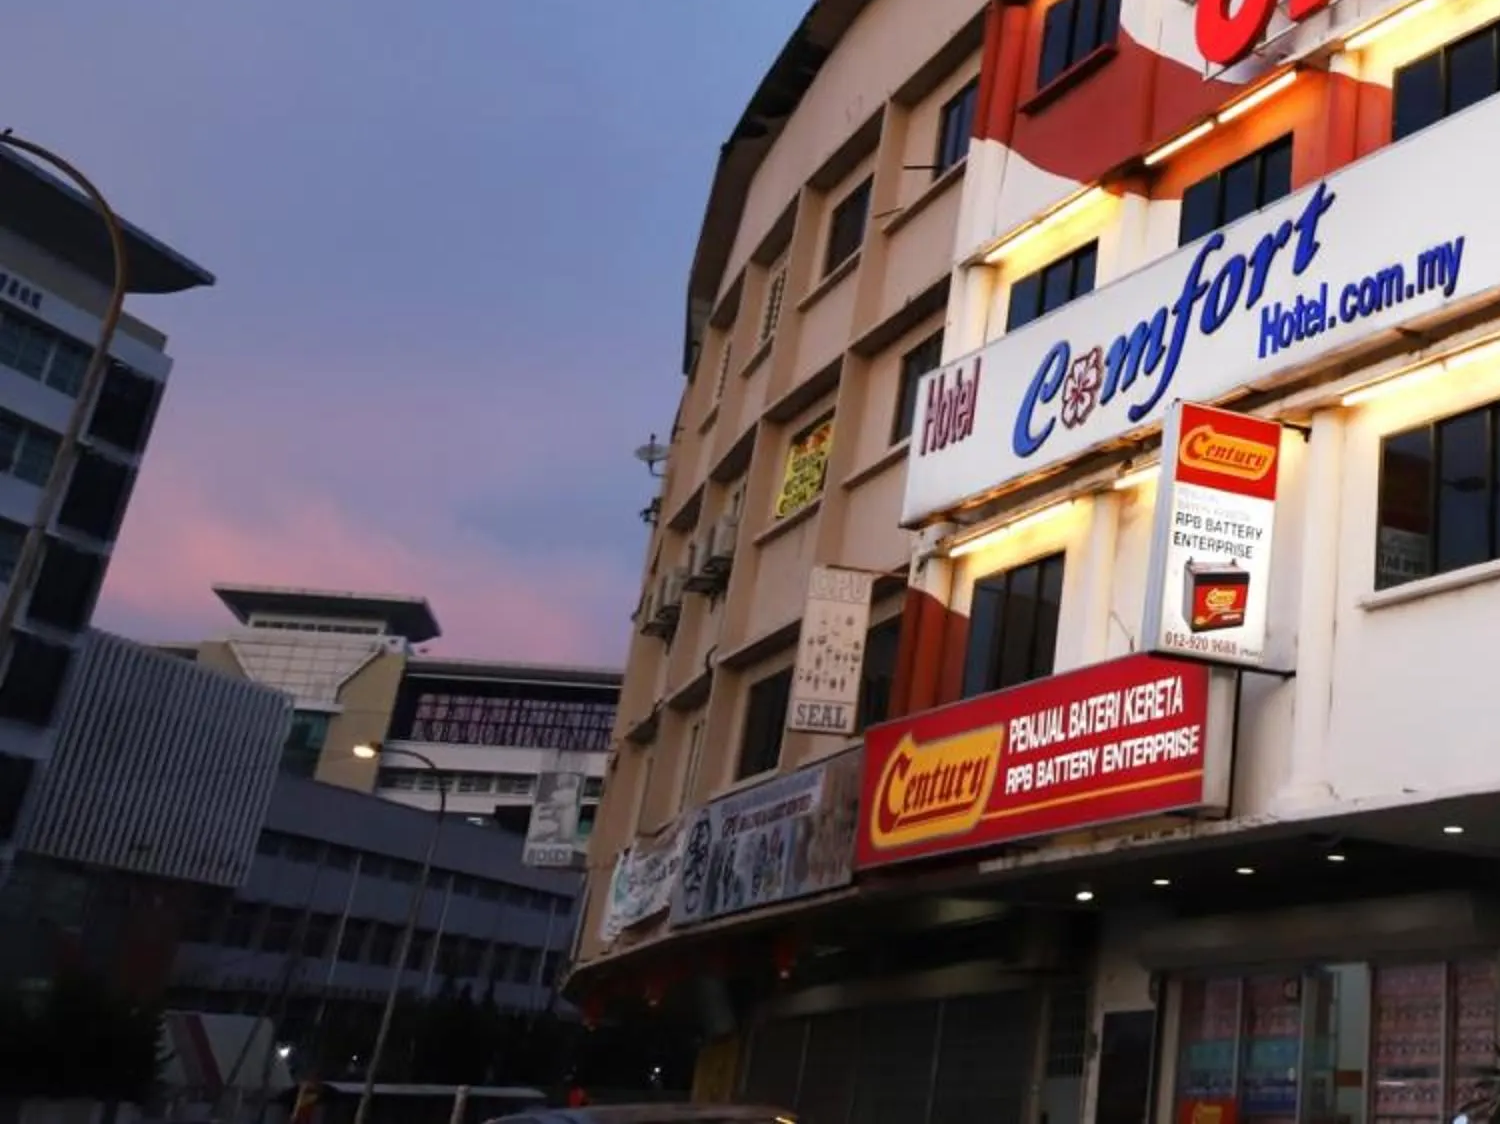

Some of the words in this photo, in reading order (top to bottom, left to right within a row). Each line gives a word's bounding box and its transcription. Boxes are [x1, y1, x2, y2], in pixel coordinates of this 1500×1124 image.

[1258, 235, 1465, 359] Hotel.com.my
[920, 357, 981, 456] Hotel
[1185, 431, 1269, 473] Century
[1173, 531, 1255, 559] ENTERPRISE
[1175, 511, 1202, 530] RPB
[1205, 517, 1263, 541] BATTERY
[795, 704, 848, 729] SEAL
[1008, 709, 1065, 754] PENJUAL
[1068, 688, 1121, 739] BATERI
[1123, 675, 1184, 726] KERETA
[878, 752, 991, 836] Century
[1005, 767, 1033, 795] RPB
[1035, 747, 1100, 790] BATTERY
[1101, 724, 1201, 773] ENTERPRISE
